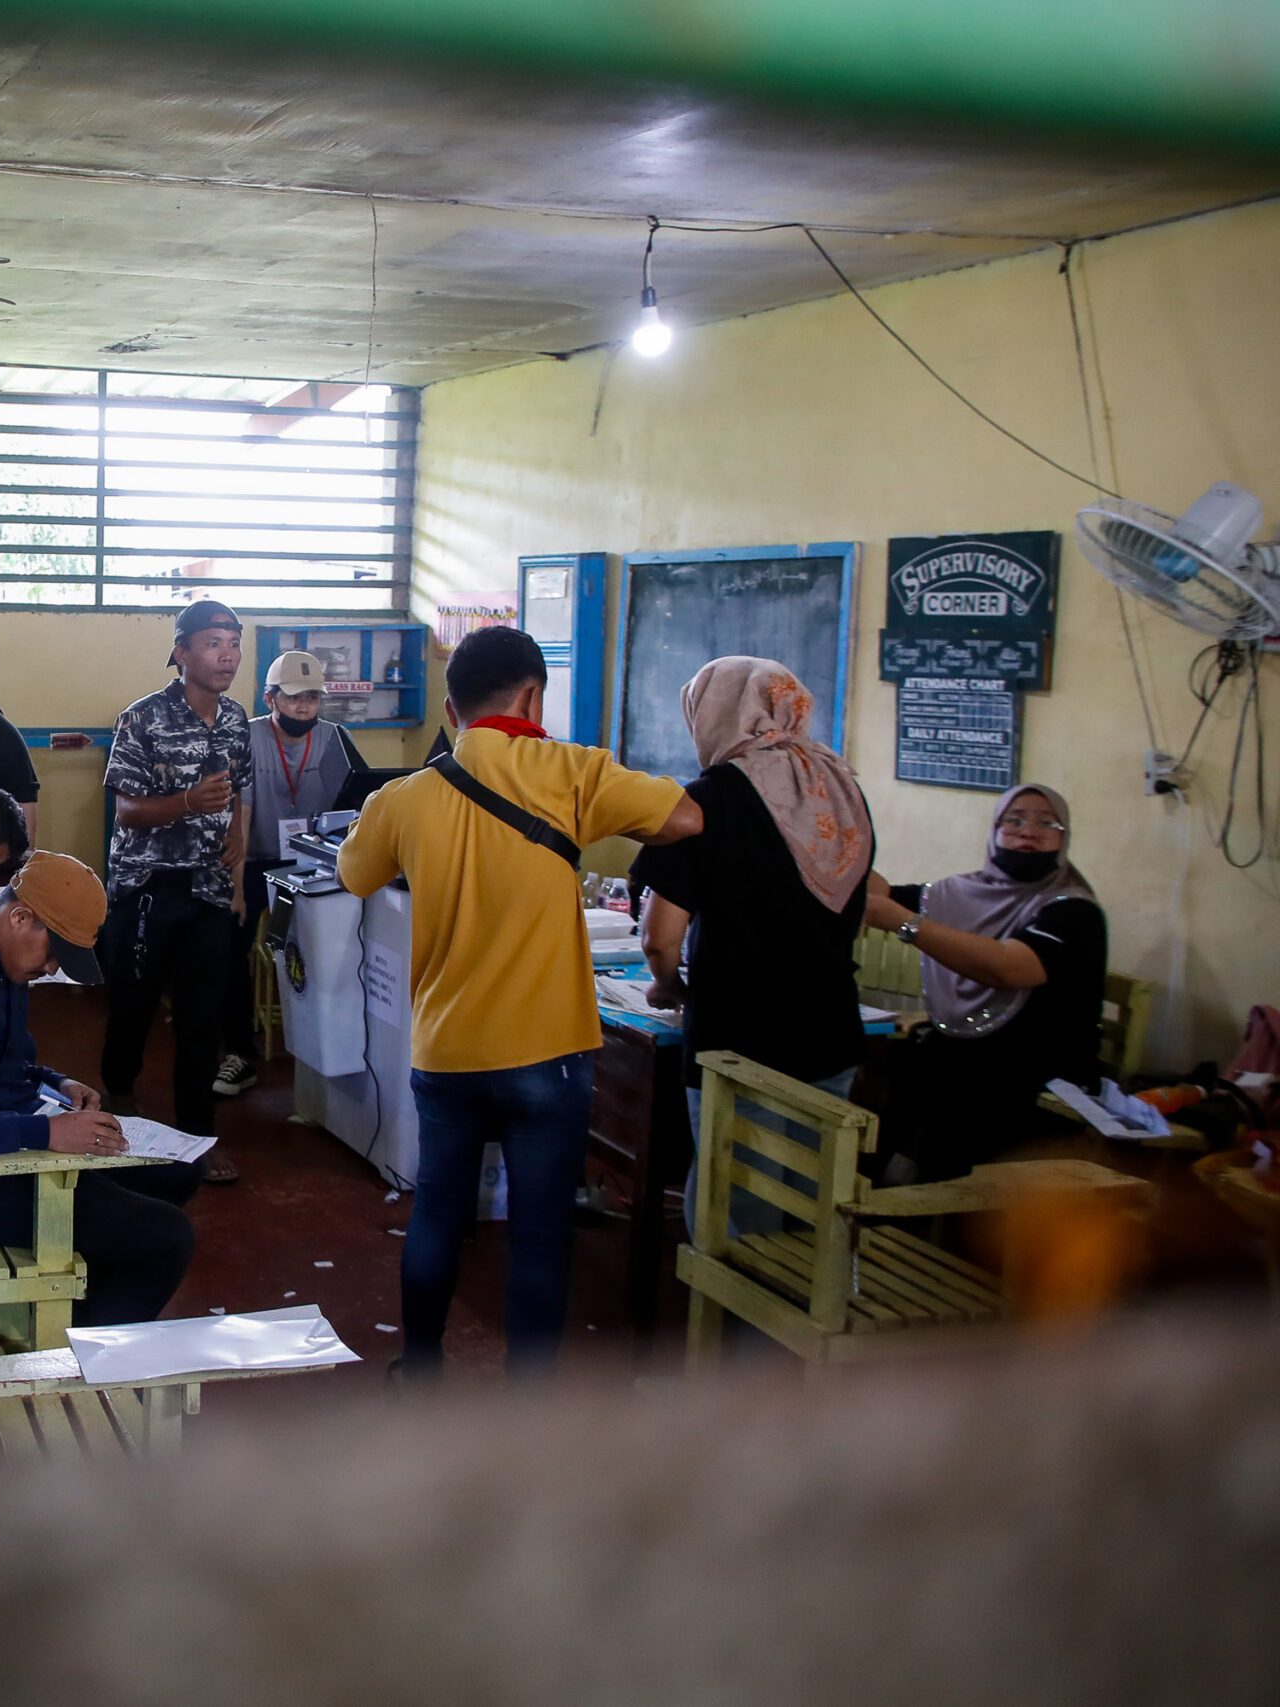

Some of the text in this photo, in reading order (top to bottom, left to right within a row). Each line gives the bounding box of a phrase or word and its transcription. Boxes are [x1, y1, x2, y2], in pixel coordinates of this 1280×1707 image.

[901, 552, 1036, 598] SUPERVISORY
[927, 595, 1000, 613] CORNER
[903, 677, 1006, 691] ATTENDANCE CHART
[907, 727, 1004, 744] DAILY ATTENDANCE
